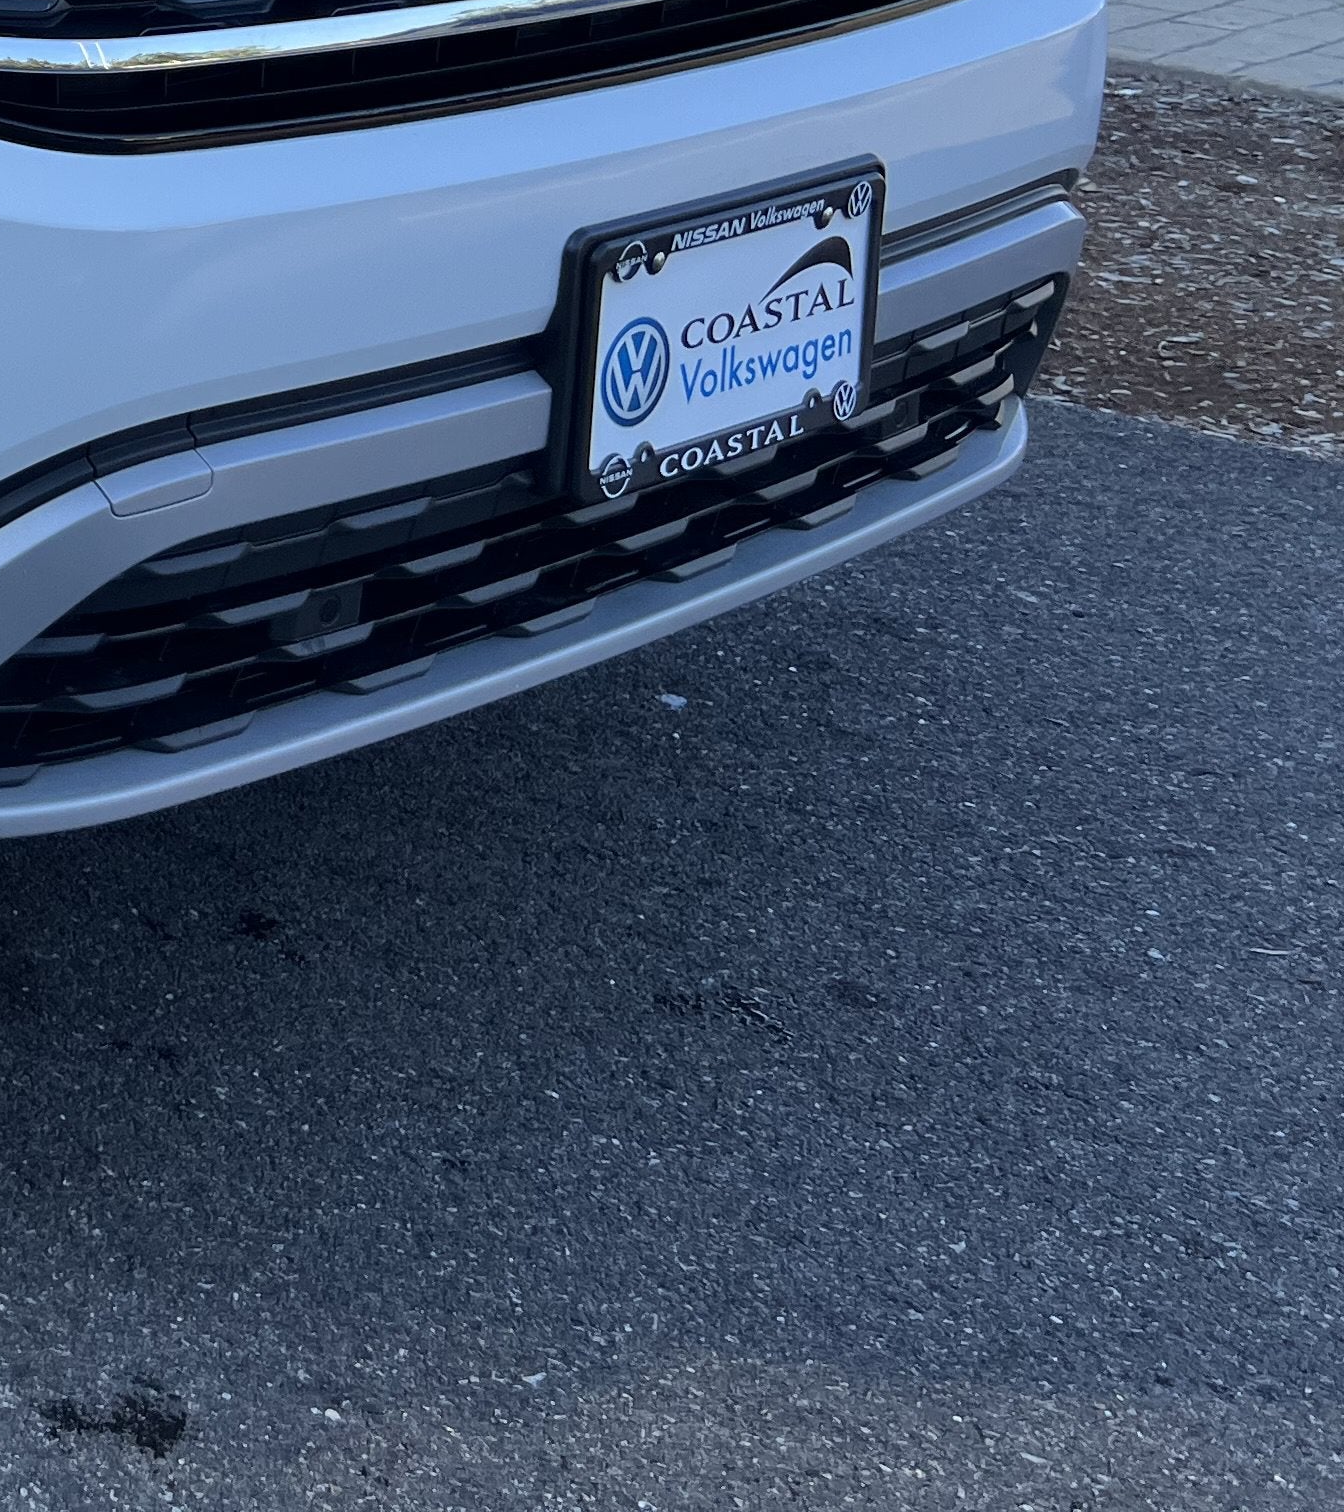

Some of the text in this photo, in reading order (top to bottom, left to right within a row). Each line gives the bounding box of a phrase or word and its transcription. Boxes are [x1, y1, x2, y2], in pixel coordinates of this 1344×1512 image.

[670, 198, 826, 252] NISSAN Volkswagen
[680, 277, 856, 350] COASTAL
[602, 318, 669, 425] VW
[679, 328, 853, 406] Volkswagen
[834, 382, 857, 421] VW
[599, 465, 634, 485] NISSAN
[659, 414, 805, 479] COASTAL
